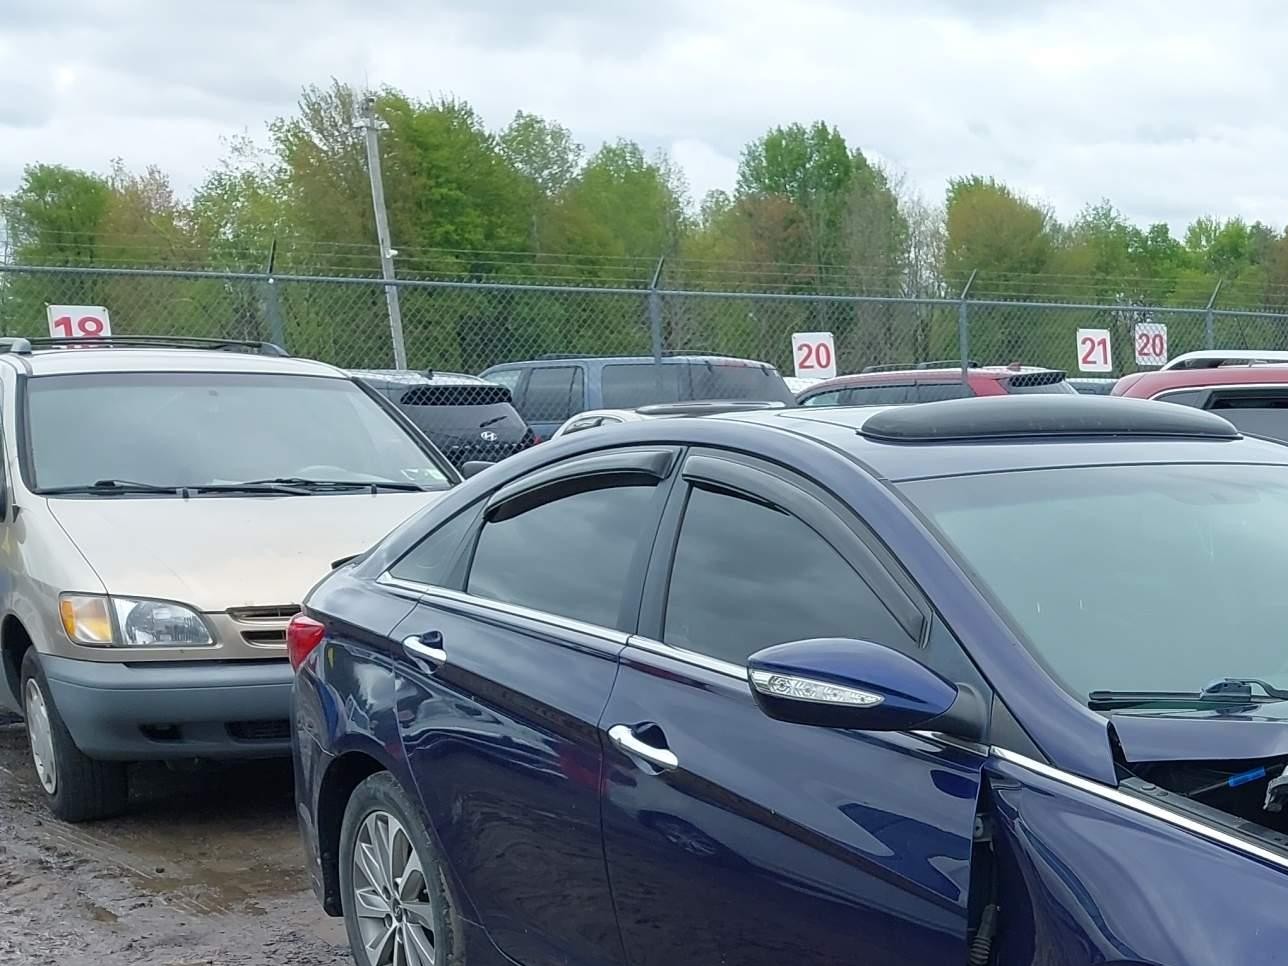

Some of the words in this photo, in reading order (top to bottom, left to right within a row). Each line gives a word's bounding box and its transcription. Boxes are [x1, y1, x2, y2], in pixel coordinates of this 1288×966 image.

[797, 342, 832, 369] 20
[1080, 336, 1109, 366] 21
[1137, 333, 1164, 357] 20
